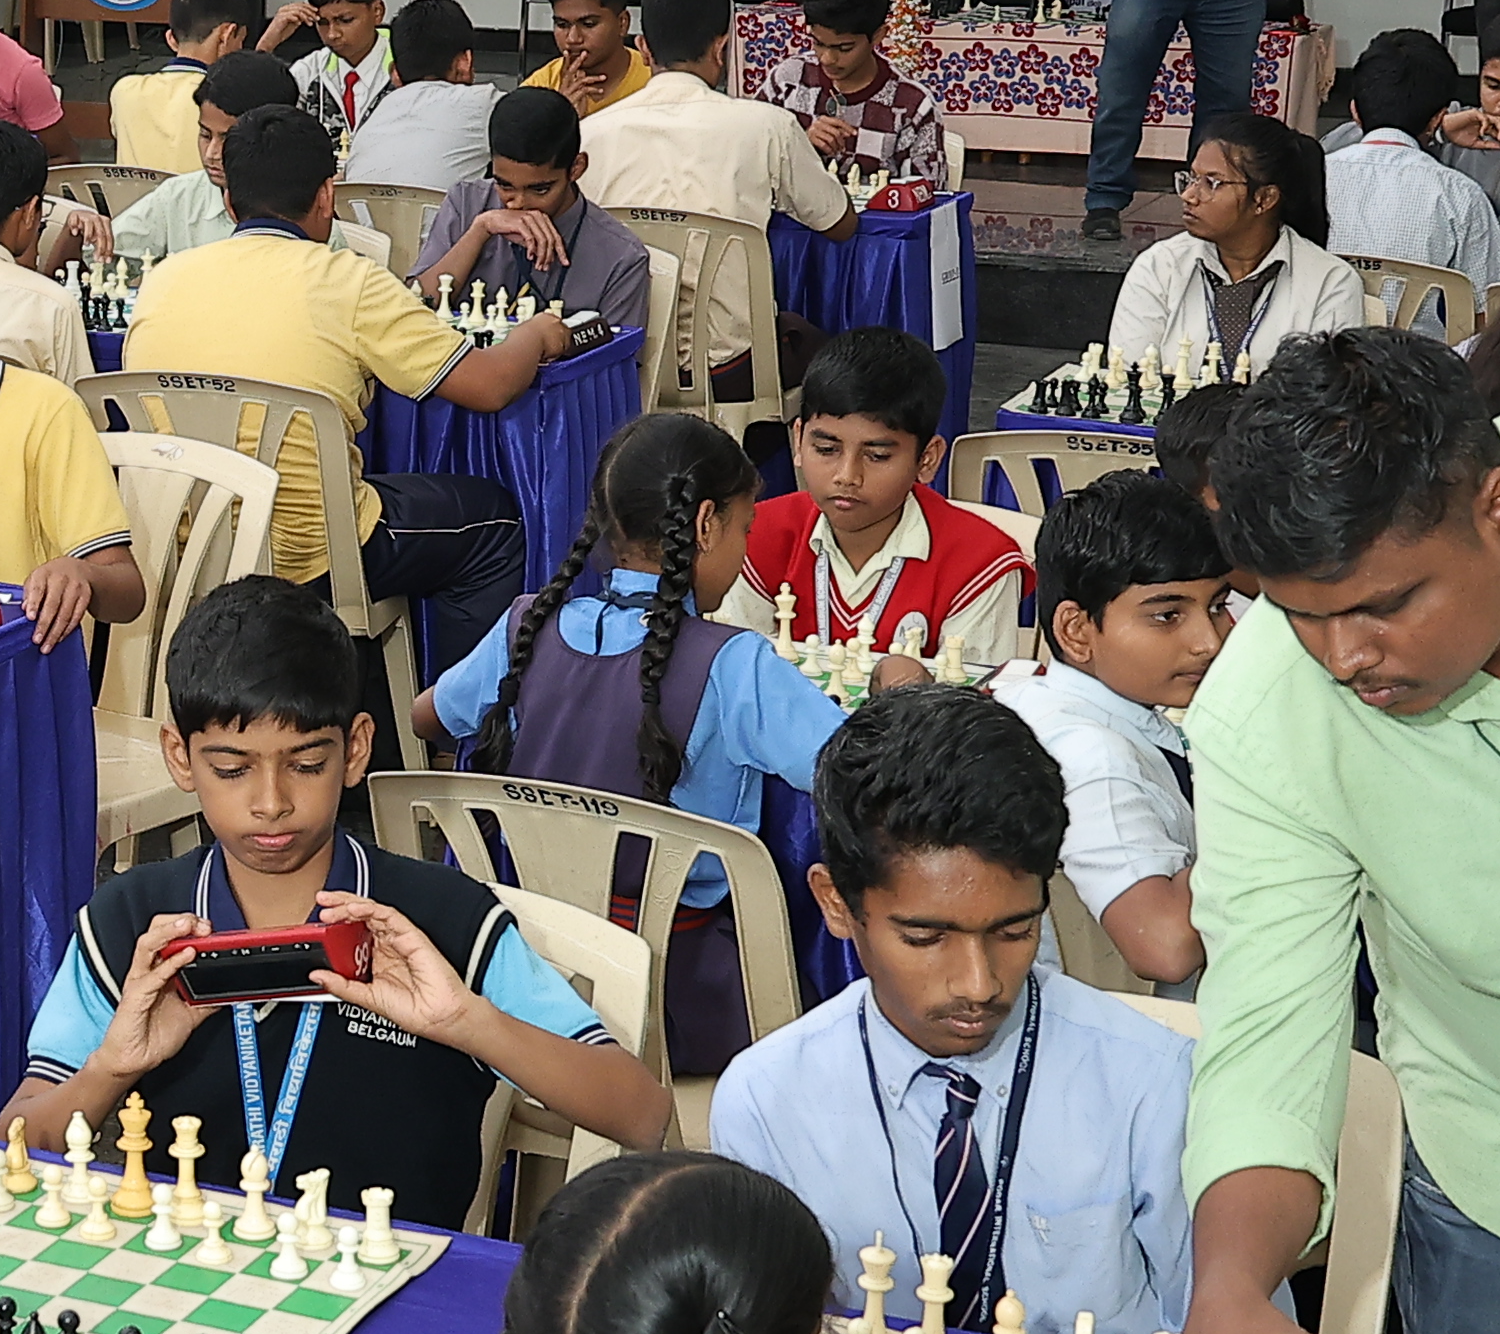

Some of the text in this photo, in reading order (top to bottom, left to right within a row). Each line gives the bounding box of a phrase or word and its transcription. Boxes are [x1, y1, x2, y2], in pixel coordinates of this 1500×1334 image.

[888, 189, 899, 208] 3
[630, 209, 687, 222] SSET-57
[157, 375, 236, 393] SSET-52
[502, 783, 620, 816] SSET-119
[347, 1020, 416, 1048] BELGAUM
[246, 1107, 266, 1155] RATHI
